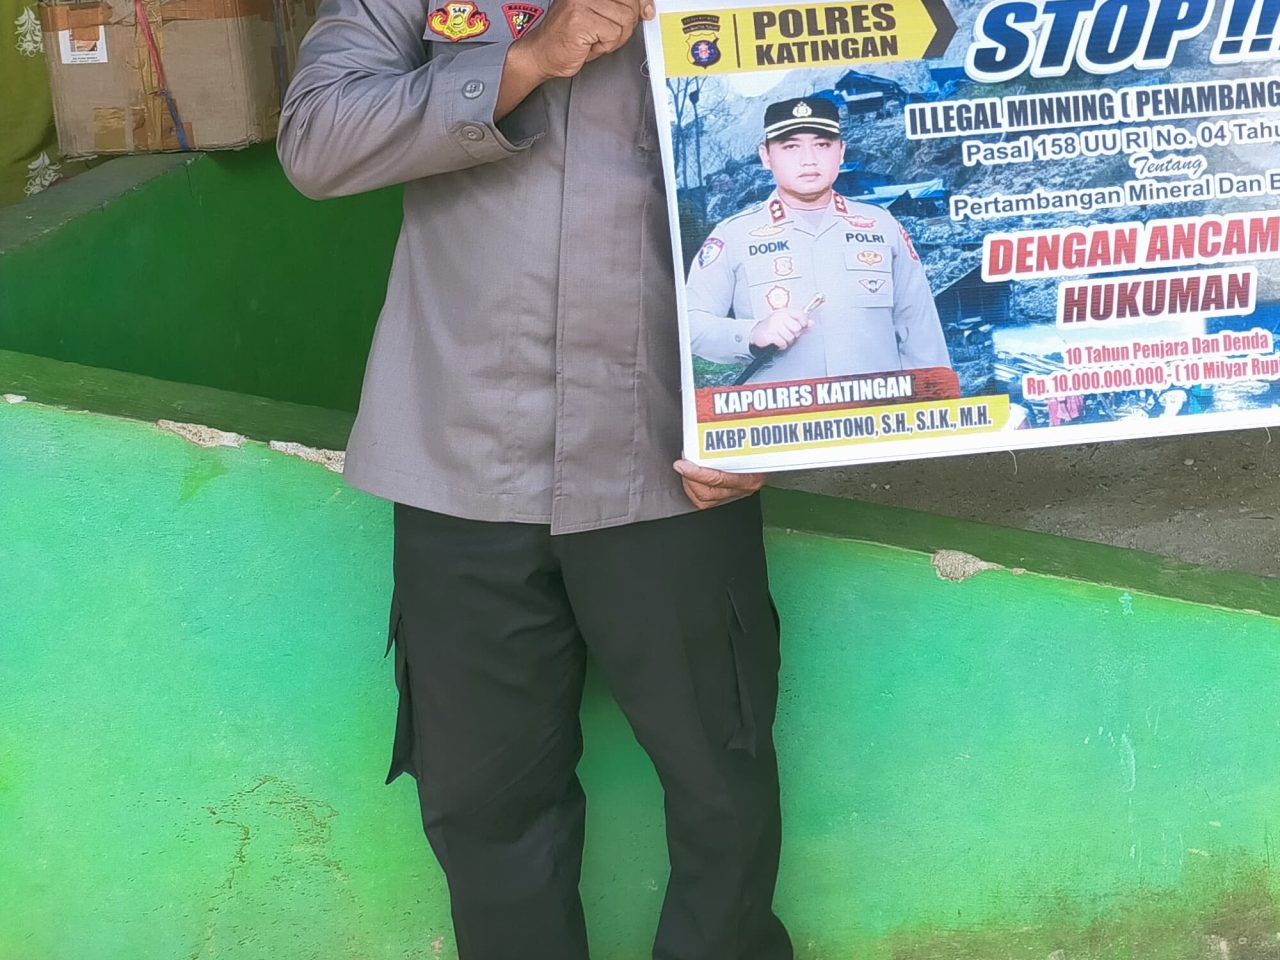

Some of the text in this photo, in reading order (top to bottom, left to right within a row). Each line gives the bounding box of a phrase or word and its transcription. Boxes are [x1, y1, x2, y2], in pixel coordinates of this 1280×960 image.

[753, 3, 897, 40] POLRES
[755, 34, 899, 66] KATINGAN
[908, 102, 1003, 136] ILLEGAL
[1007, 93, 1115, 128] MINNING
[967, 138, 1030, 164] Pasal
[1037, 135, 1076, 157] 158
[1083, 131, 1118, 154] UU
[1125, 129, 1150, 151] RI
[1156, 125, 1194, 148] No.
[1200, 123, 1228, 145] 04
[1133, 155, 1204, 178] Tentang
[954, 188, 1122, 218] Pertambangan
[1128, 179, 1212, 205] Mineral
[1218, 176, 1263, 196] Dan
[748, 240, 790, 257] DODIK
[845, 232, 886, 244] POLRI
[986, 229, 1139, 277] DENGAN
[1062, 273, 1252, 324] HUKUMAN
[1065, 333, 1270, 366] 10 Tahun Penjara Dan Denda
[713, 376, 912, 416] KAPOLRES KATINGAN
[1026, 377, 1049, 398] Rp.
[1184, 364, 1201, 383] 10
[1203, 359, 1249, 383] Milyar
[705, 405, 992, 451] AKBP DODIK HARTONO, S.H., S.I.K., M.H.
